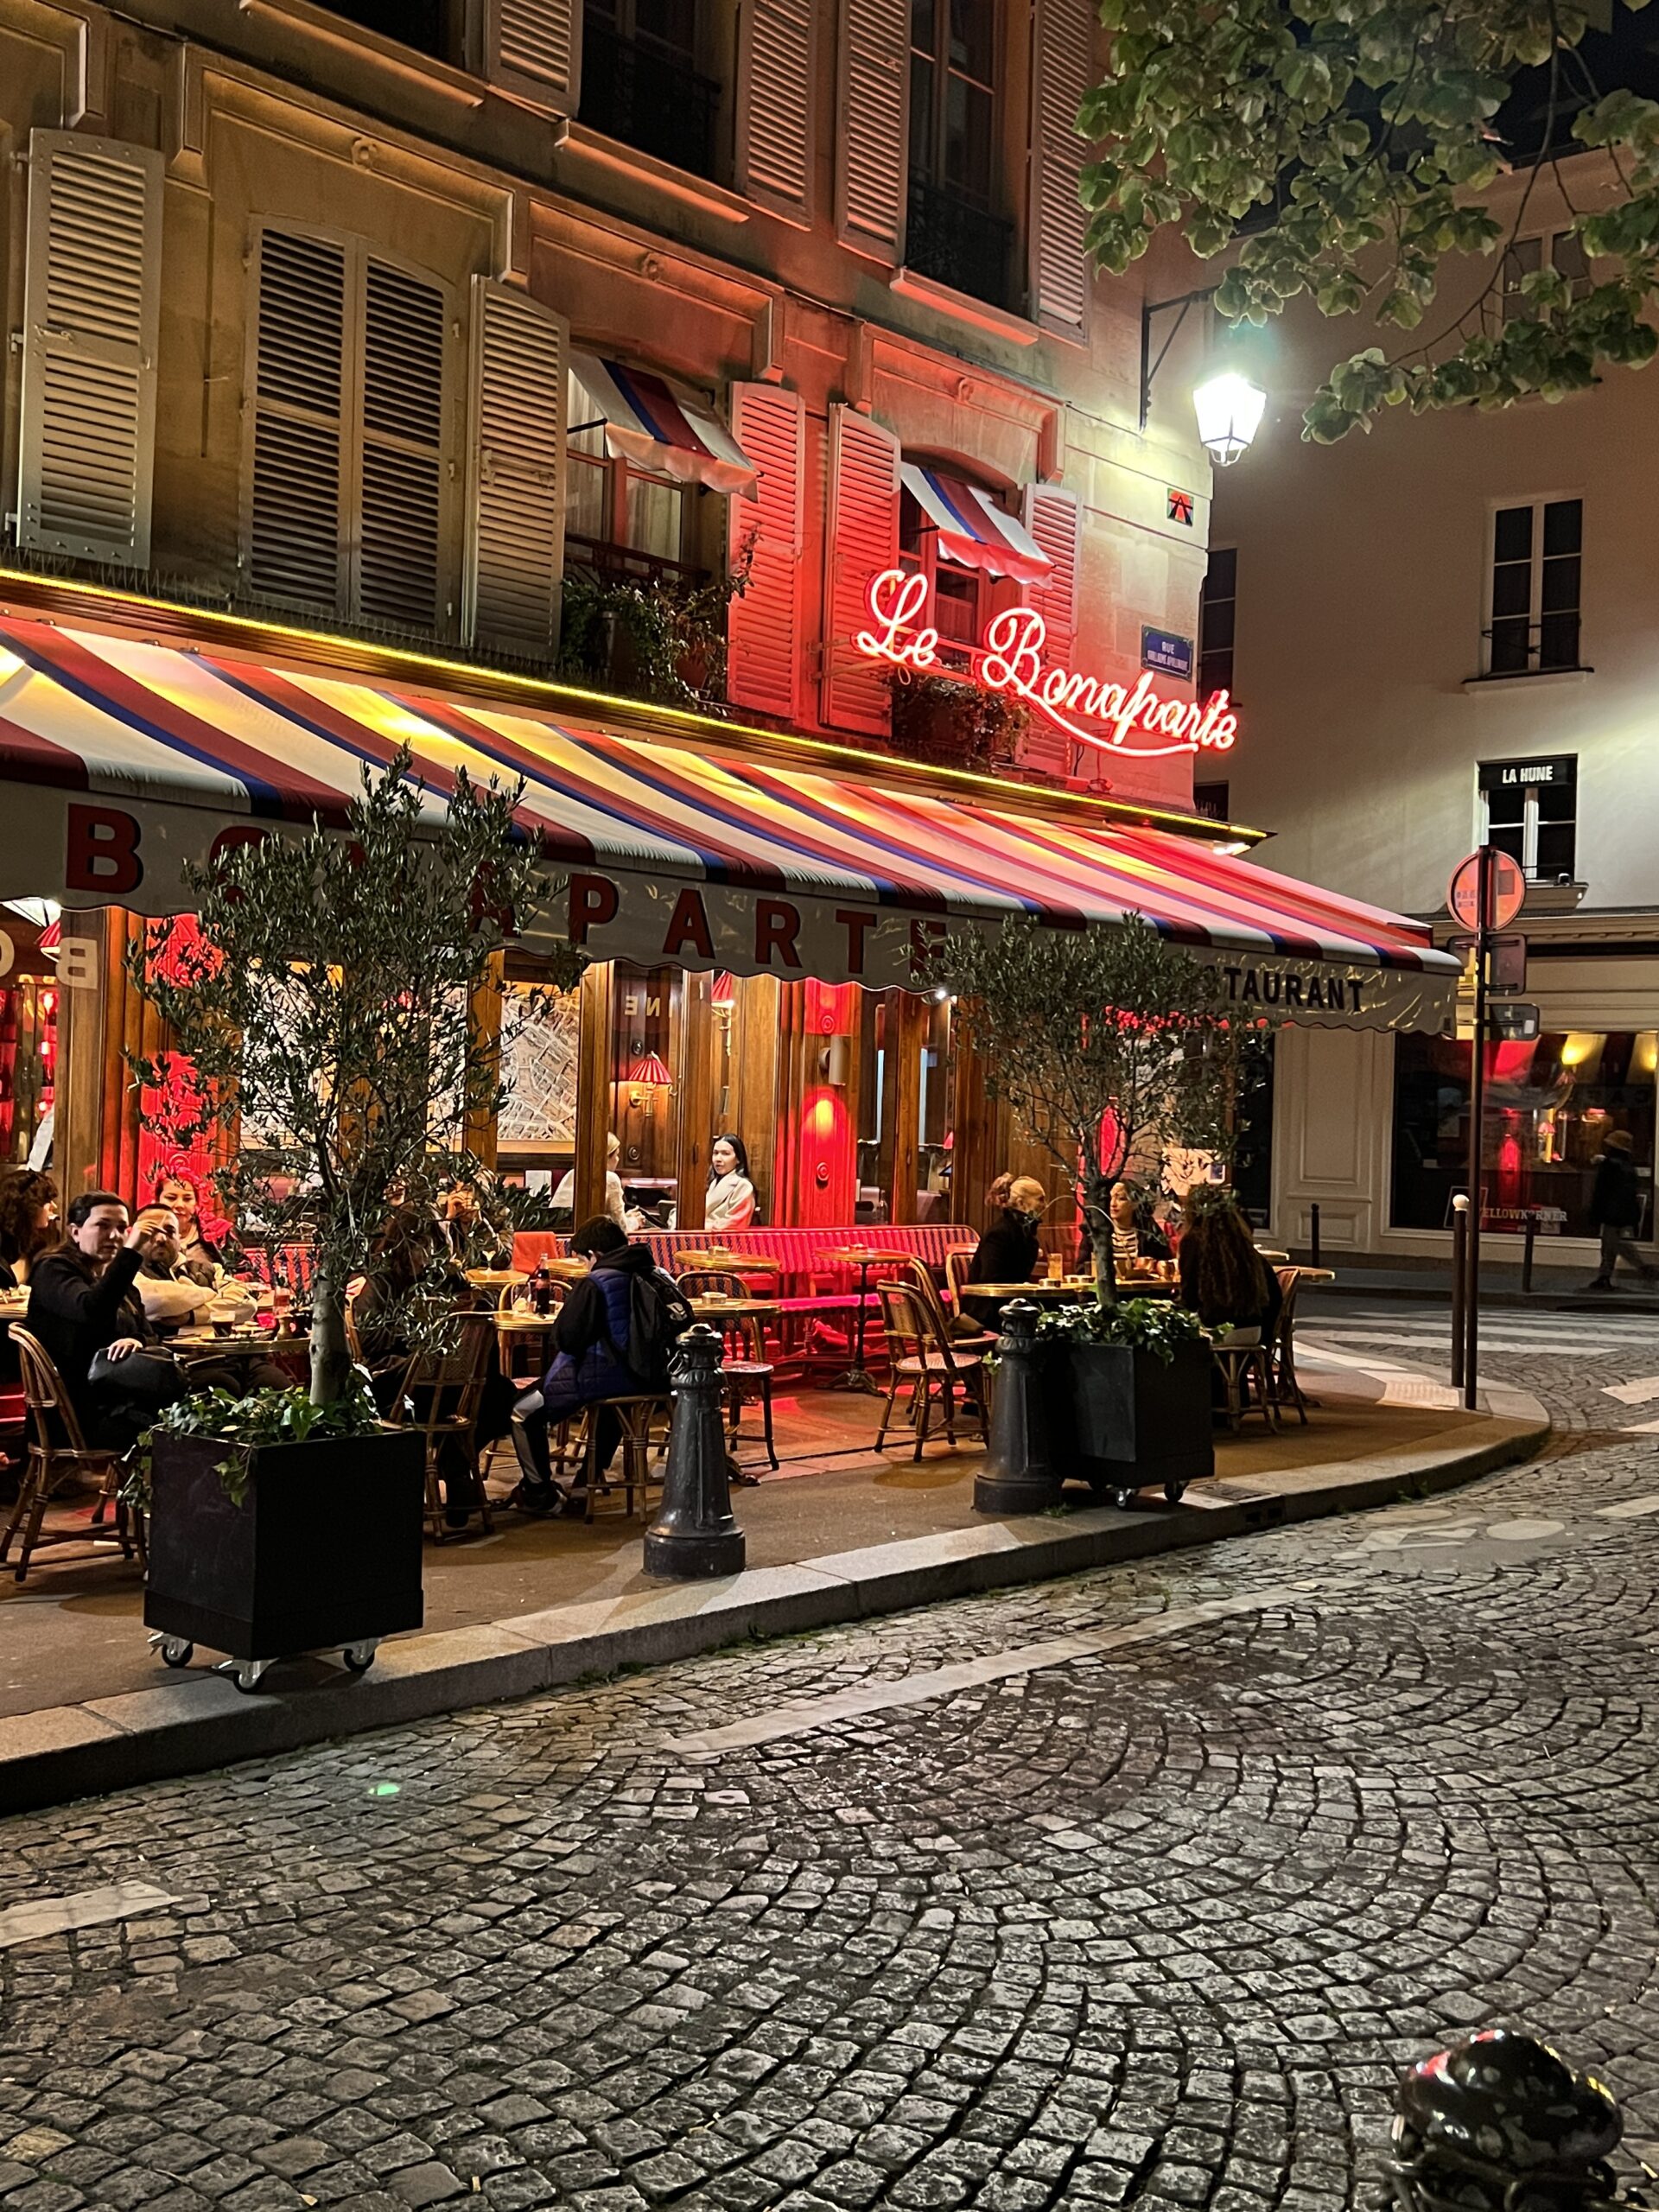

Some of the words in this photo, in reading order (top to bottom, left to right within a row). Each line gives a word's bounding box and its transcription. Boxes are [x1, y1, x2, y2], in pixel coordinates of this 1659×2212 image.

[1161, 641, 1175, 655] RUE
[855, 568, 938, 668] Le
[978, 607, 1240, 759] Bonaparte
[1502, 768, 1516, 784] LA
[1520, 766, 1553, 782] HUNE
